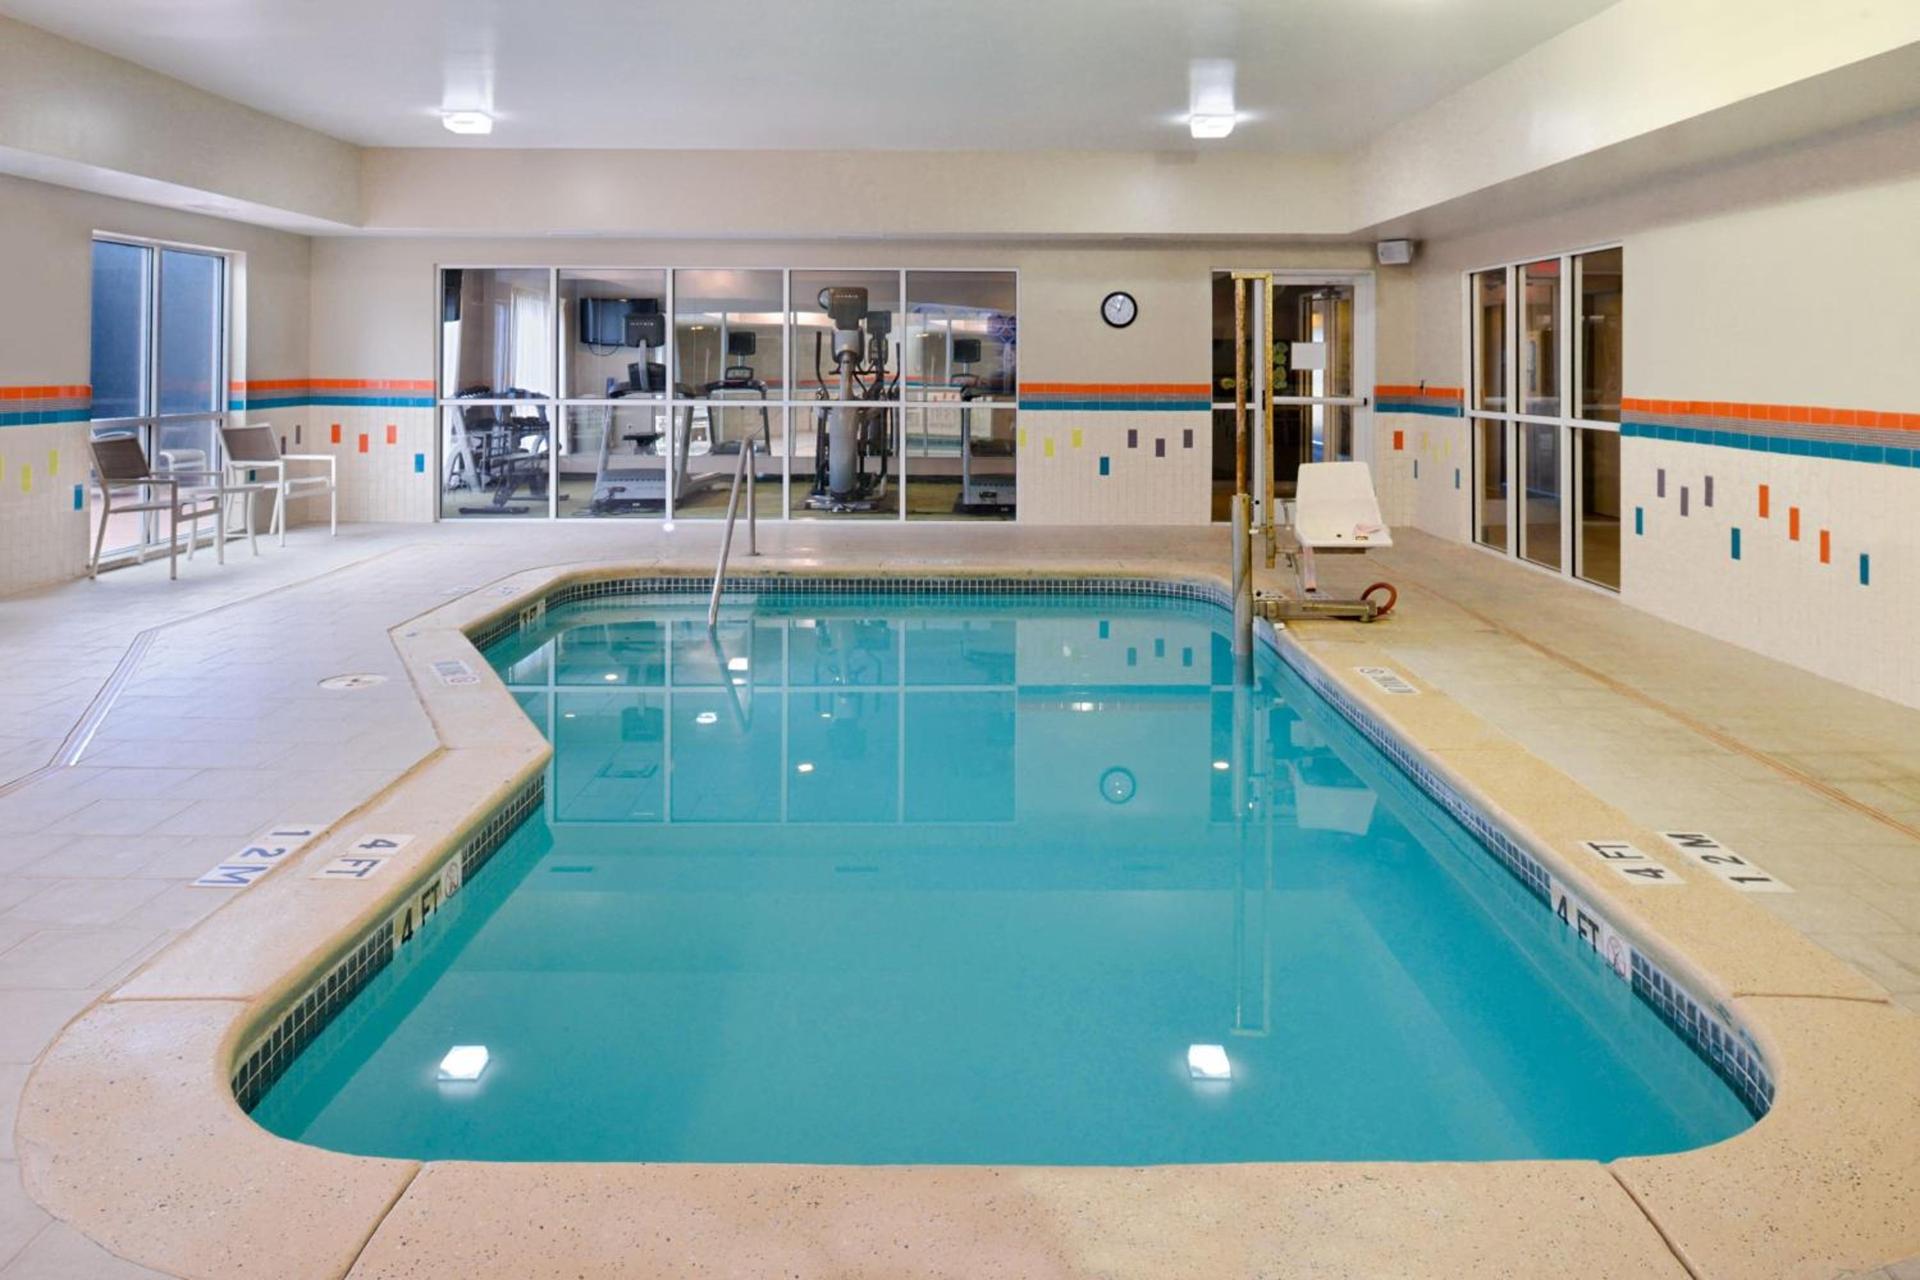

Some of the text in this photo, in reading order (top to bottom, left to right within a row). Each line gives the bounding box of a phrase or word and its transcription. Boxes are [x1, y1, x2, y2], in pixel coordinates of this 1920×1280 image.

[326, 837, 398, 878] 4 FT
[1587, 841, 1665, 880] 4 FT
[401, 880, 441, 943] 4 FT
[1557, 894, 1600, 953] 4 FT
